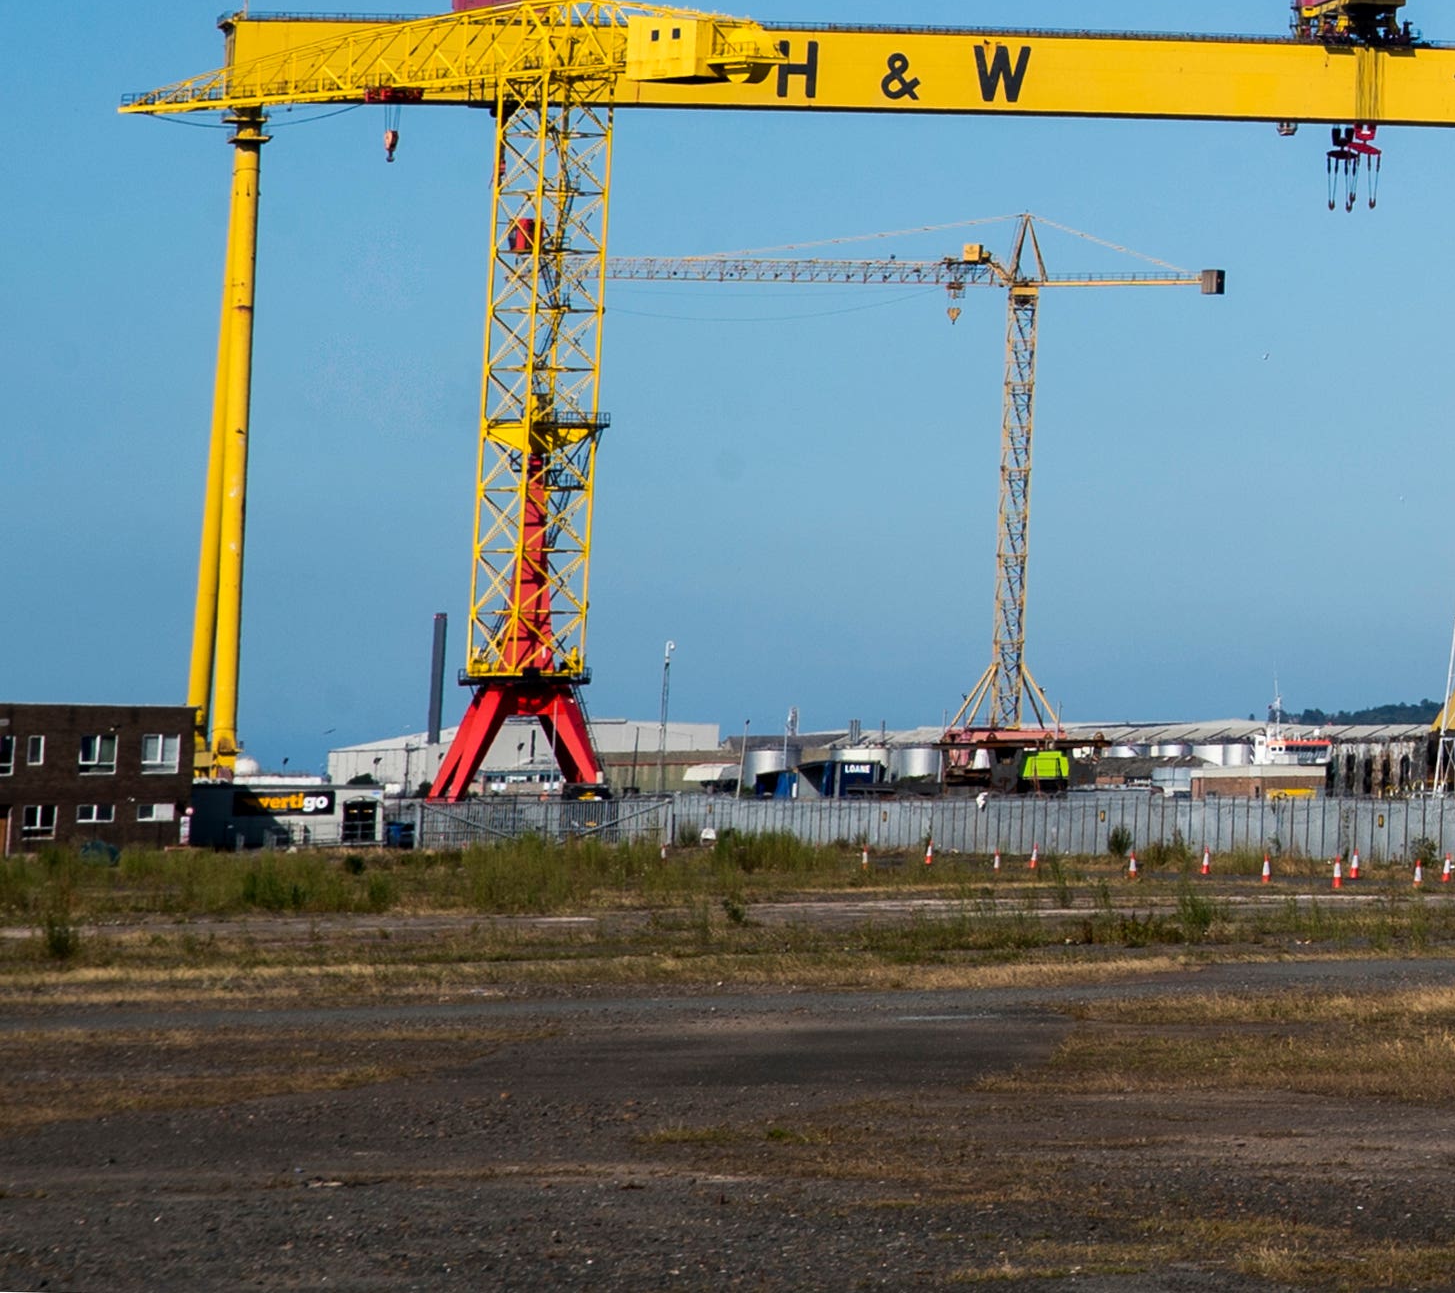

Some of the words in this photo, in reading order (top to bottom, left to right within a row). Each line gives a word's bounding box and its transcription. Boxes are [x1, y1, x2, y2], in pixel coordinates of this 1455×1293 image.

[776, 39, 818, 99] H
[881, 52, 921, 100] &
[973, 44, 1031, 103] W
[257, 792, 329, 812] vertigo
